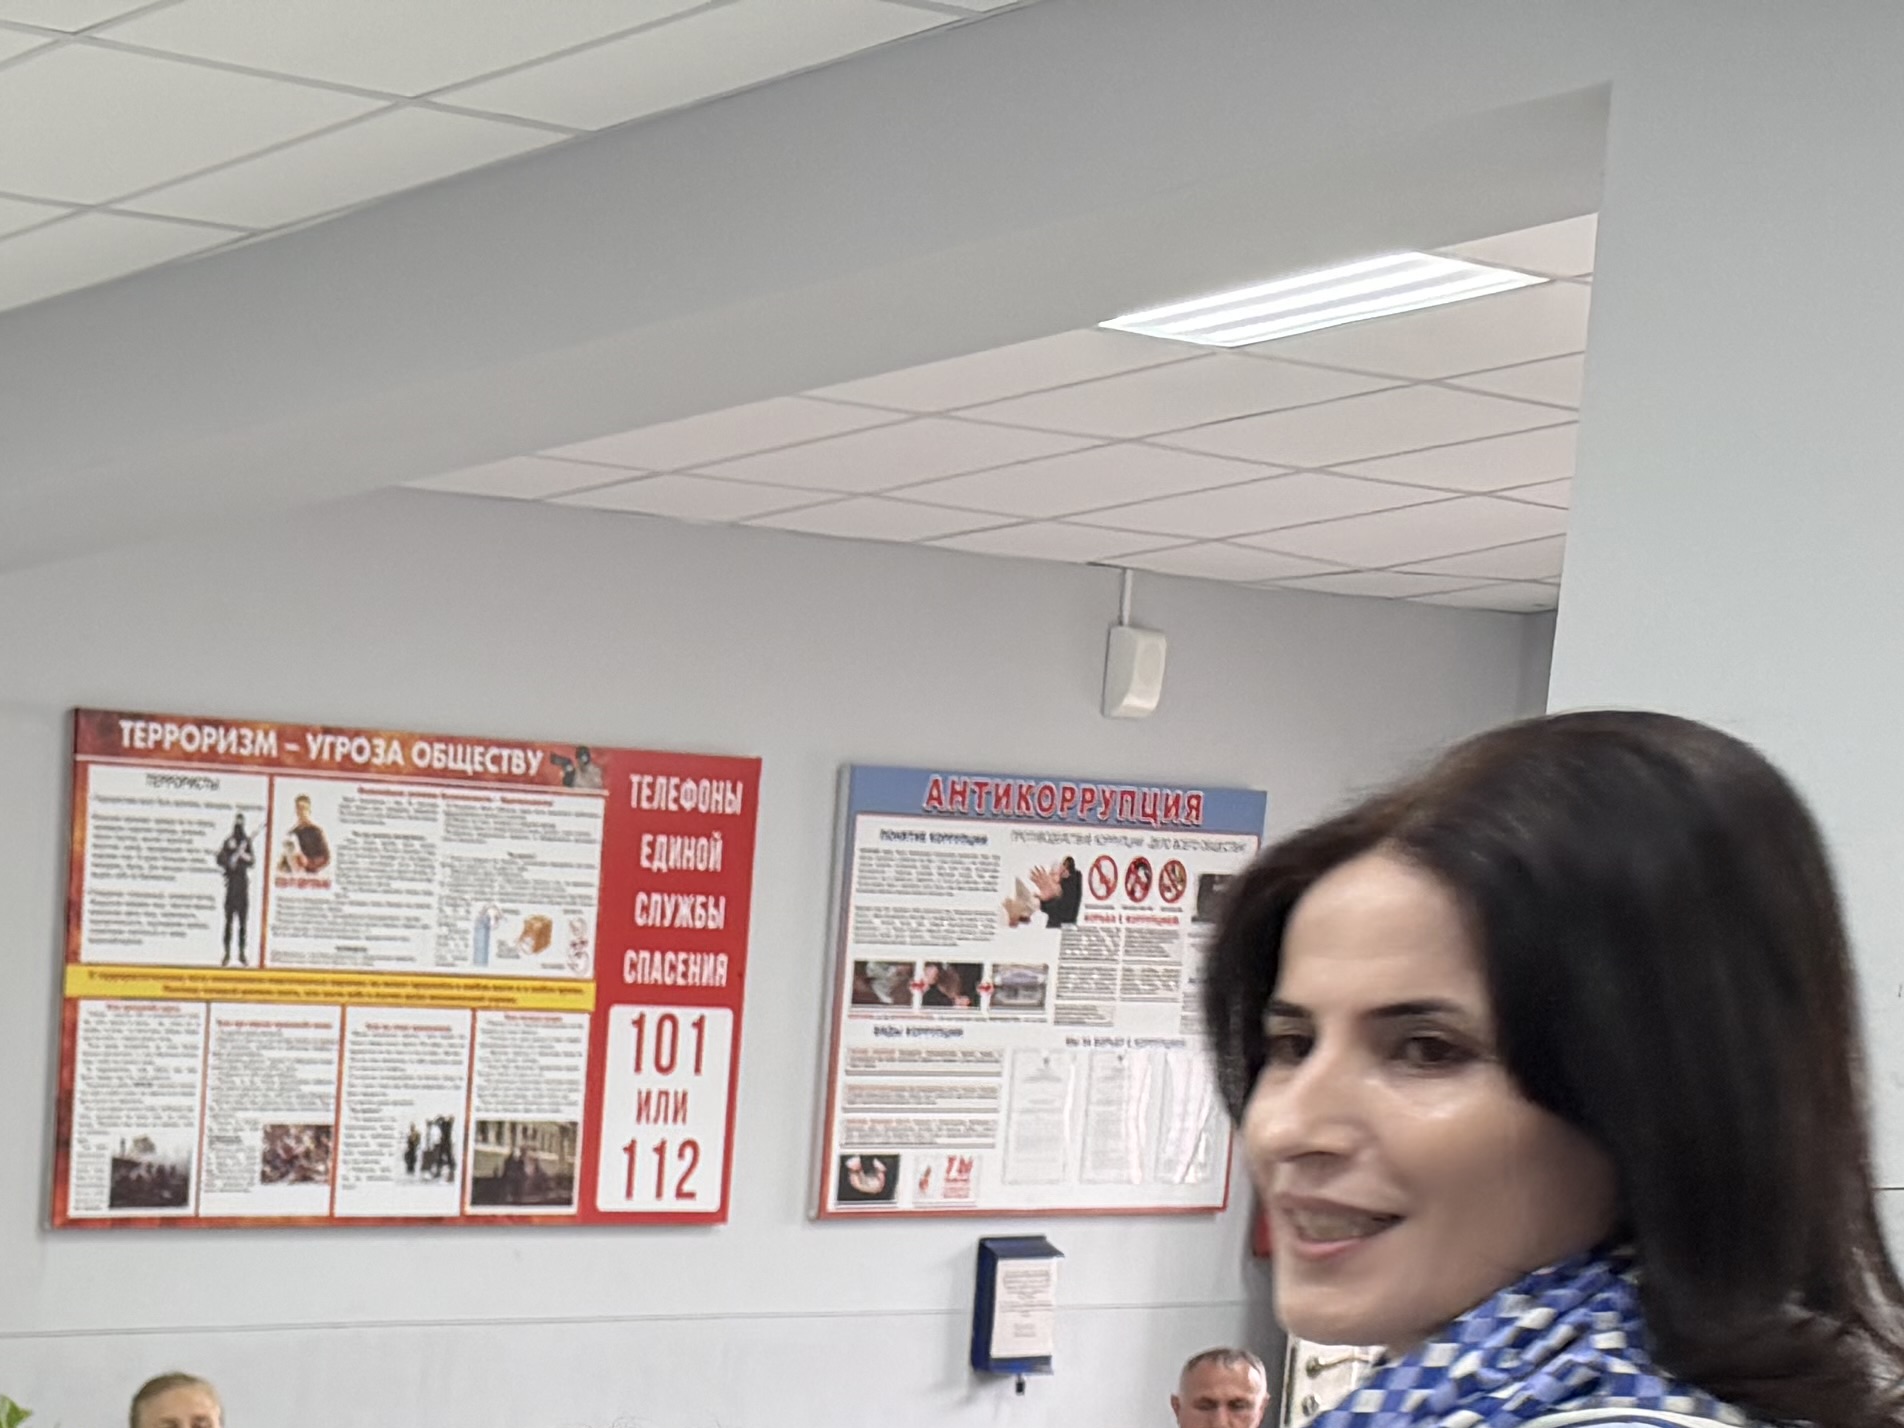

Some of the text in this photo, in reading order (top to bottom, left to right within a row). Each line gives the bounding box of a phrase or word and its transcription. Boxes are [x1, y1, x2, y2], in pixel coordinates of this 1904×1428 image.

[120, 720, 277, 757] ТЕРРОРИЗМ
[307, 732, 404, 766] УГРОЗА
[412, 741, 544, 776] ОБЩЕСТВУ
[146, 773, 220, 790] ТЕРРОРИСТЫ
[630, 773, 743, 815] ТЕЛЕФОНЫ
[923, 774, 1204, 827] АНТИКОРРУПЦИЯ
[640, 831, 723, 873] ЕДИНОЙ
[634, 892, 726, 930] СЛУЖБЫ
[624, 949, 728, 987] СПАСЕНИЯ
[631, 1012, 707, 1076] 101
[636, 1087, 688, 1126] ИЛИ
[622, 1138, 701, 1202] 112
